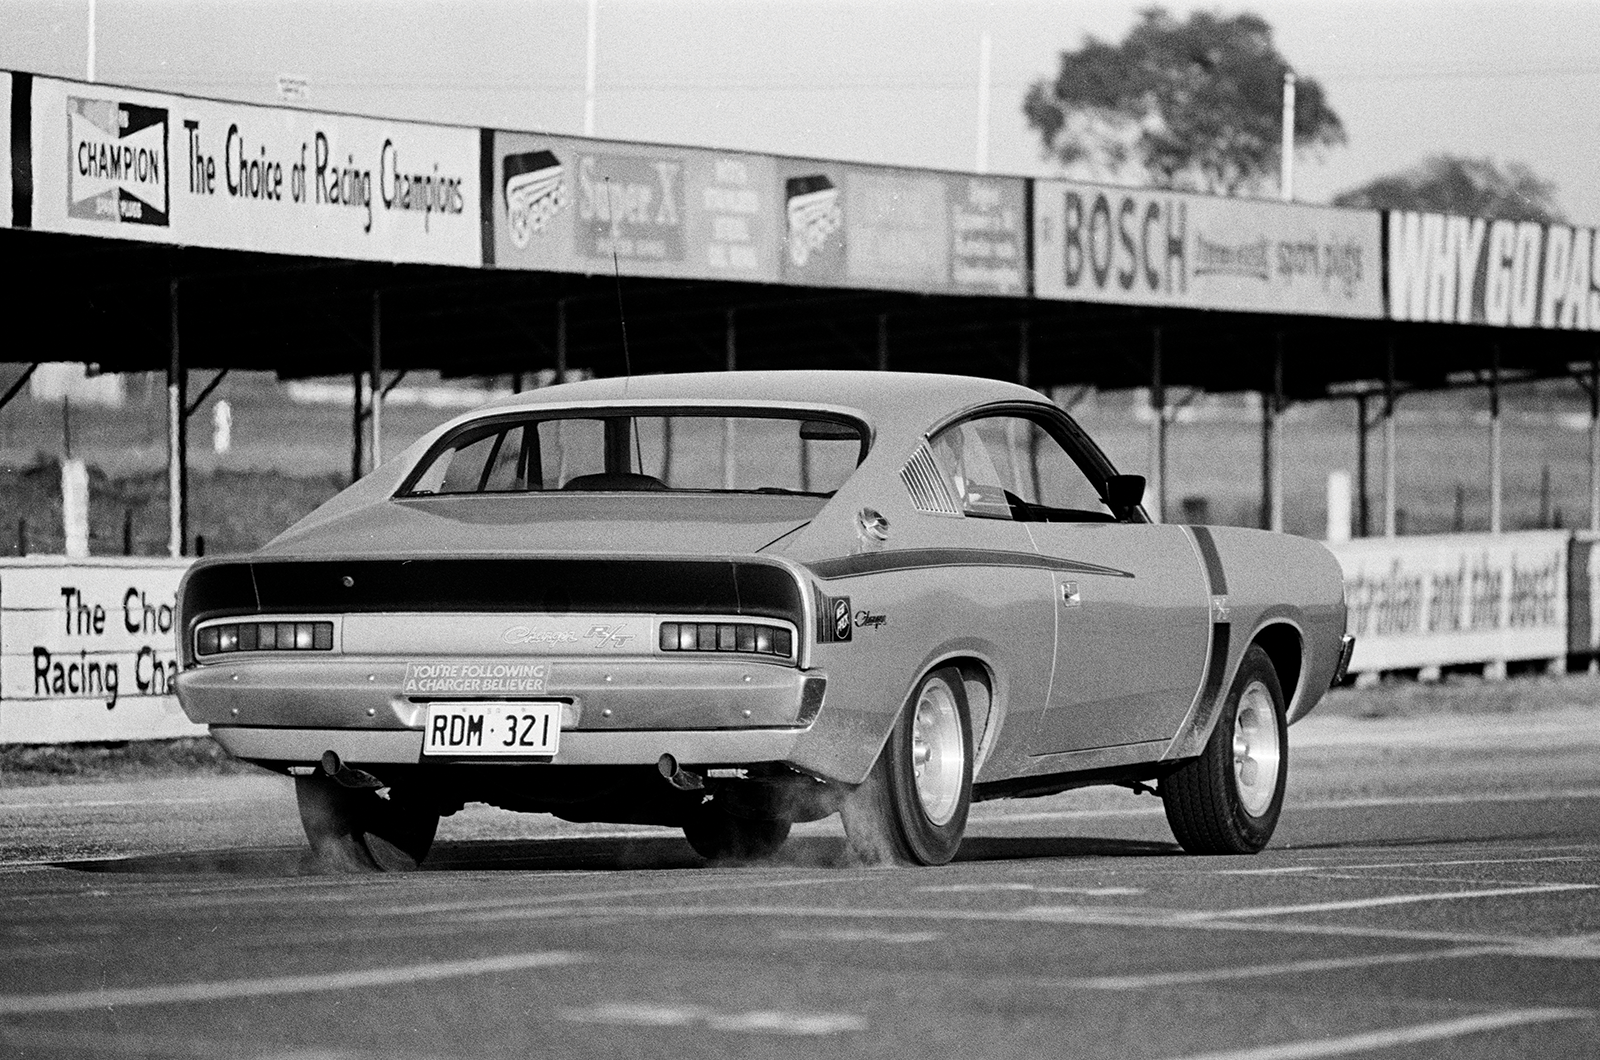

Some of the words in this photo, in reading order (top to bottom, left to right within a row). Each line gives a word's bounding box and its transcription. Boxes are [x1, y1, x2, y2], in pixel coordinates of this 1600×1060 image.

[78, 140, 159, 184] CHAMPION
[183, 119, 215, 195] The
[225, 123, 282, 201] Choice
[291, 142, 307, 203] of
[315, 131, 371, 233] Racing
[380, 138, 463, 233] Champions
[1064, 192, 1187, 295] BOSCH
[1389, 209, 1486, 323] WHY
[1484, 219, 1543, 328] GO
[61, 587, 105, 635] The
[583, 624, 636, 649] R/T
[33, 646, 118, 710] Racing
[405, 679, 418, 691] A
[418, 679, 480, 692] CHARGER
[482, 679, 543, 691] BELIEVER
[412, 665, 459, 678] YOU'RE
[461, 665, 545, 678] FOLLOWING
[431, 714, 484, 746] RDM
[502, 714, 549, 746] 321
